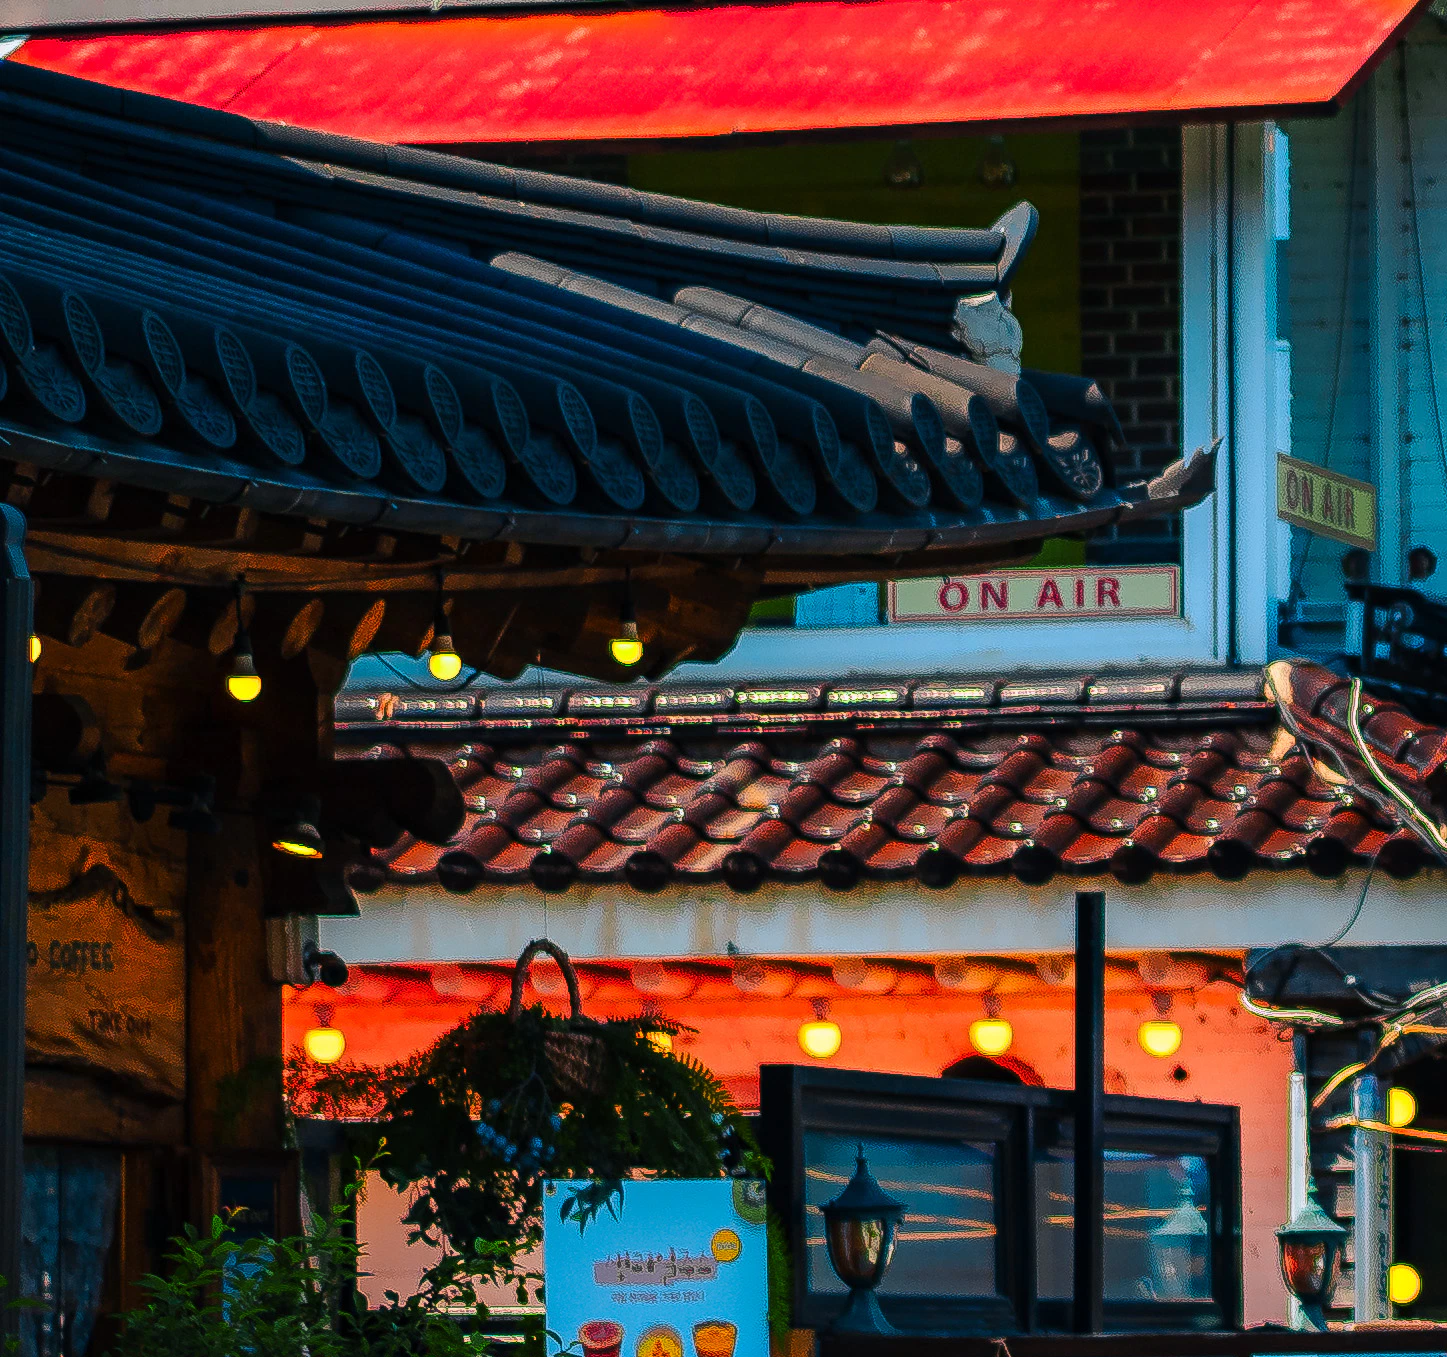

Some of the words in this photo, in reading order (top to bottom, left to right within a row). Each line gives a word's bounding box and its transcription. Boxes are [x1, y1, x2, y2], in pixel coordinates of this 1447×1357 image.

[1286, 469, 1314, 517] ON
[1322, 487, 1356, 530] AIR
[938, 577, 1008, 611] ON
[1037, 575, 1122, 609] AIR
